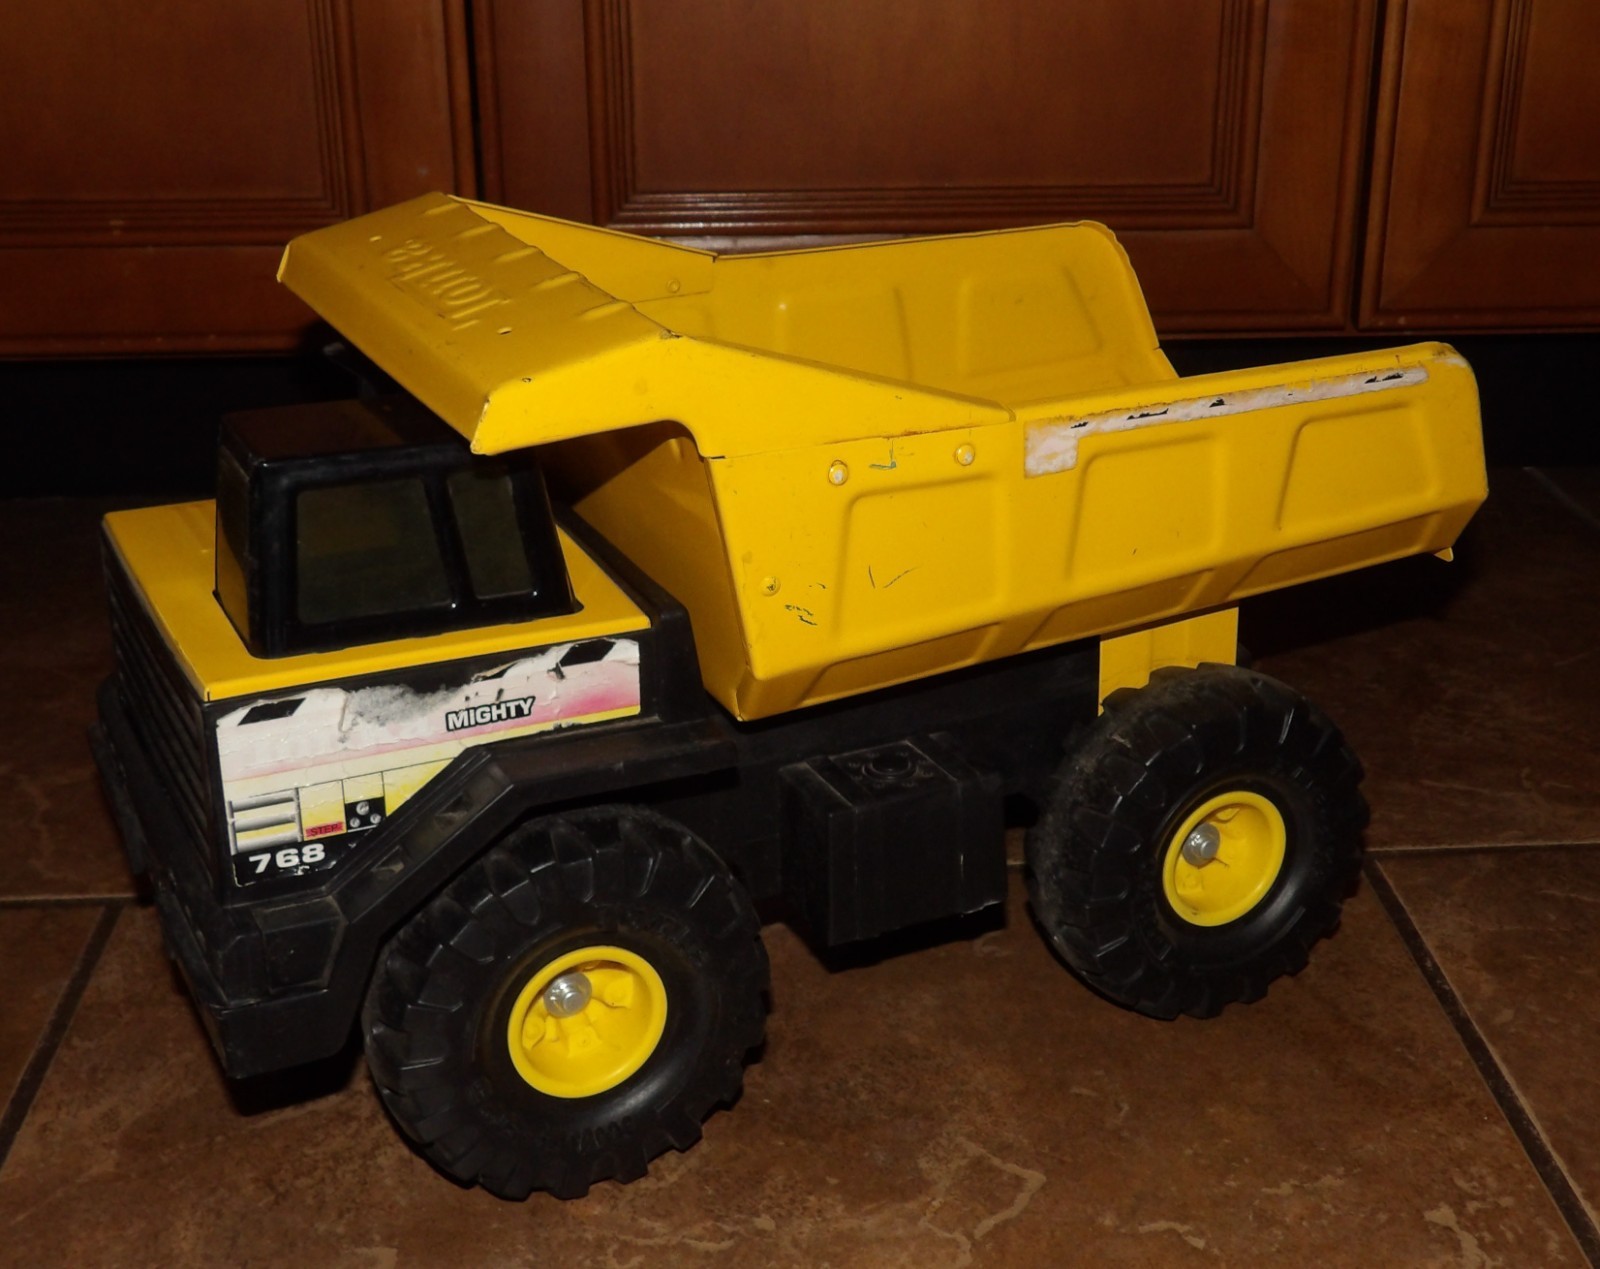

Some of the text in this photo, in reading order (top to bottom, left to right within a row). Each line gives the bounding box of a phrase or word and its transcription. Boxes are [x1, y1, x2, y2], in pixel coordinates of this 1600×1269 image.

[446, 697, 534, 731] MIGHTY
[310, 823, 339, 837] STEP
[249, 843, 325, 874] 768
